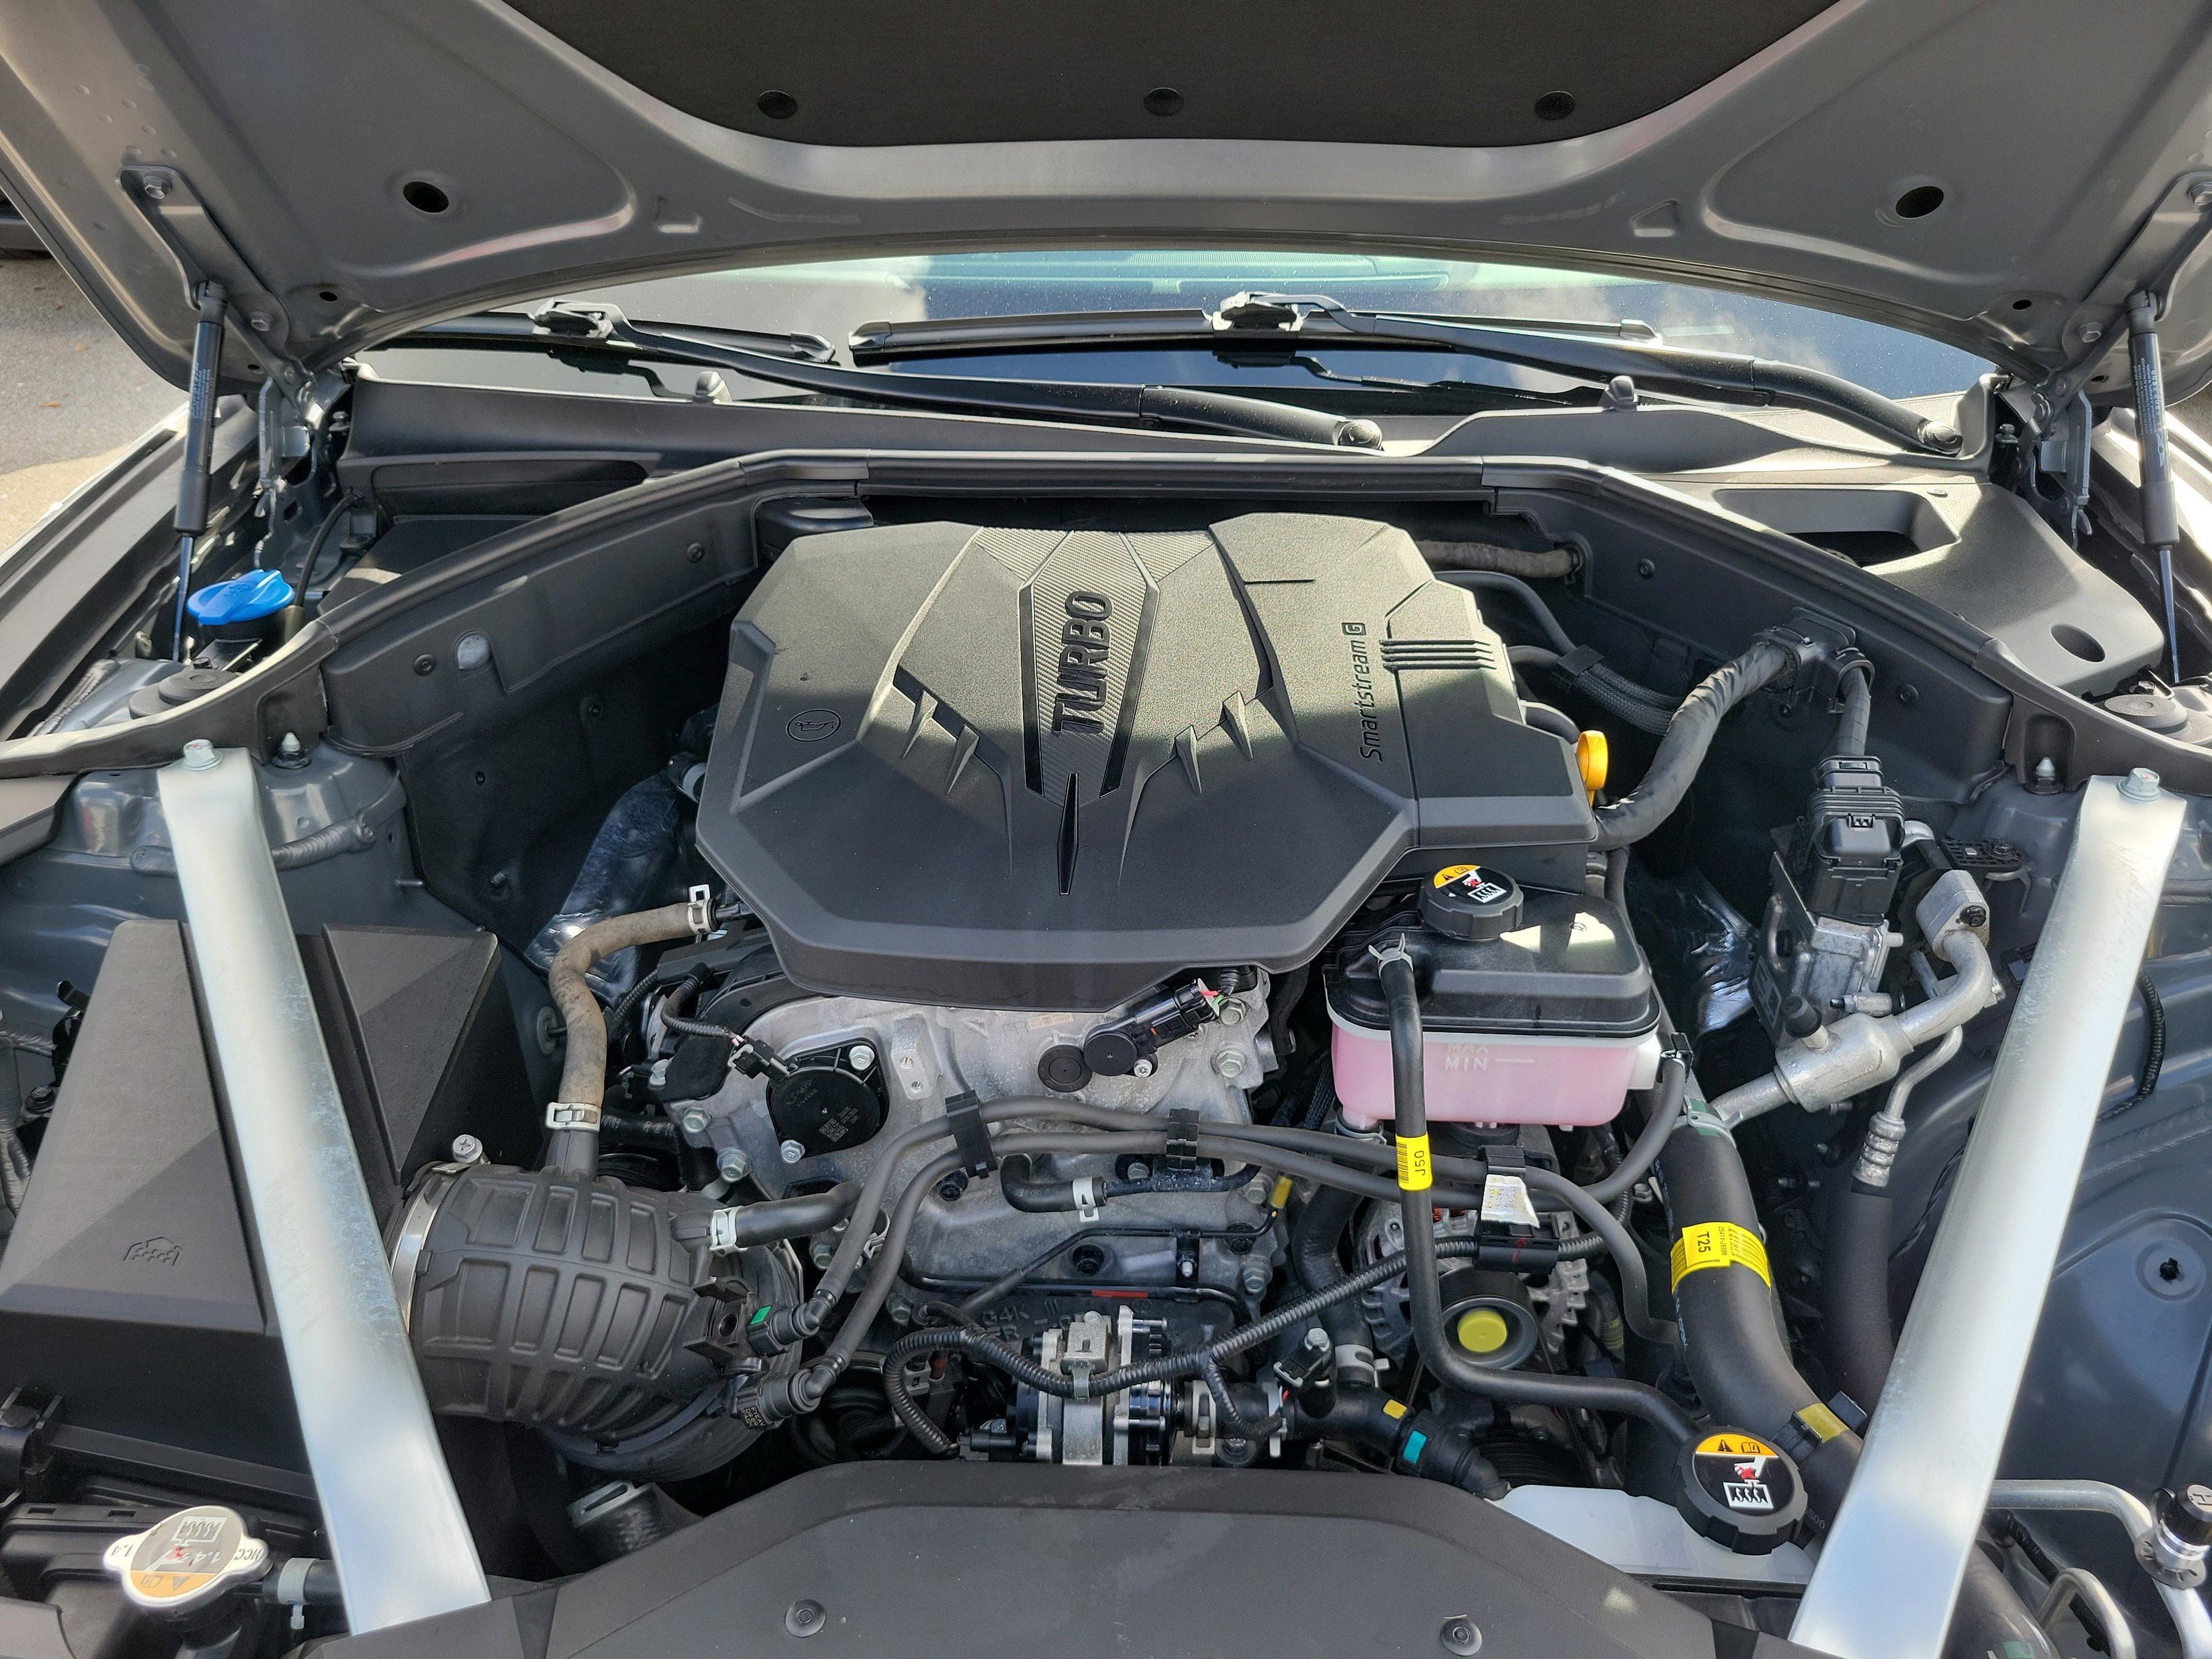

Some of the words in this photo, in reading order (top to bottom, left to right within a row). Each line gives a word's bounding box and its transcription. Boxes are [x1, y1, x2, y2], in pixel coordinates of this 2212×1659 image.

[1342, 623, 1365, 635] G
[1051, 590, 1112, 734] TURBO
[1349, 639, 1382, 762] Smartstream
[1444, 1056, 1488, 1071] MIN
[1414, 1148, 1426, 1177] J50
[1697, 1230, 1711, 1253] T25
[1804, 1506, 1825, 1529] 500
[111, 1544, 134, 1558] 1.4
[194, 1551, 221, 1564] 1.4
[233, 1548, 263, 1562] HCC
